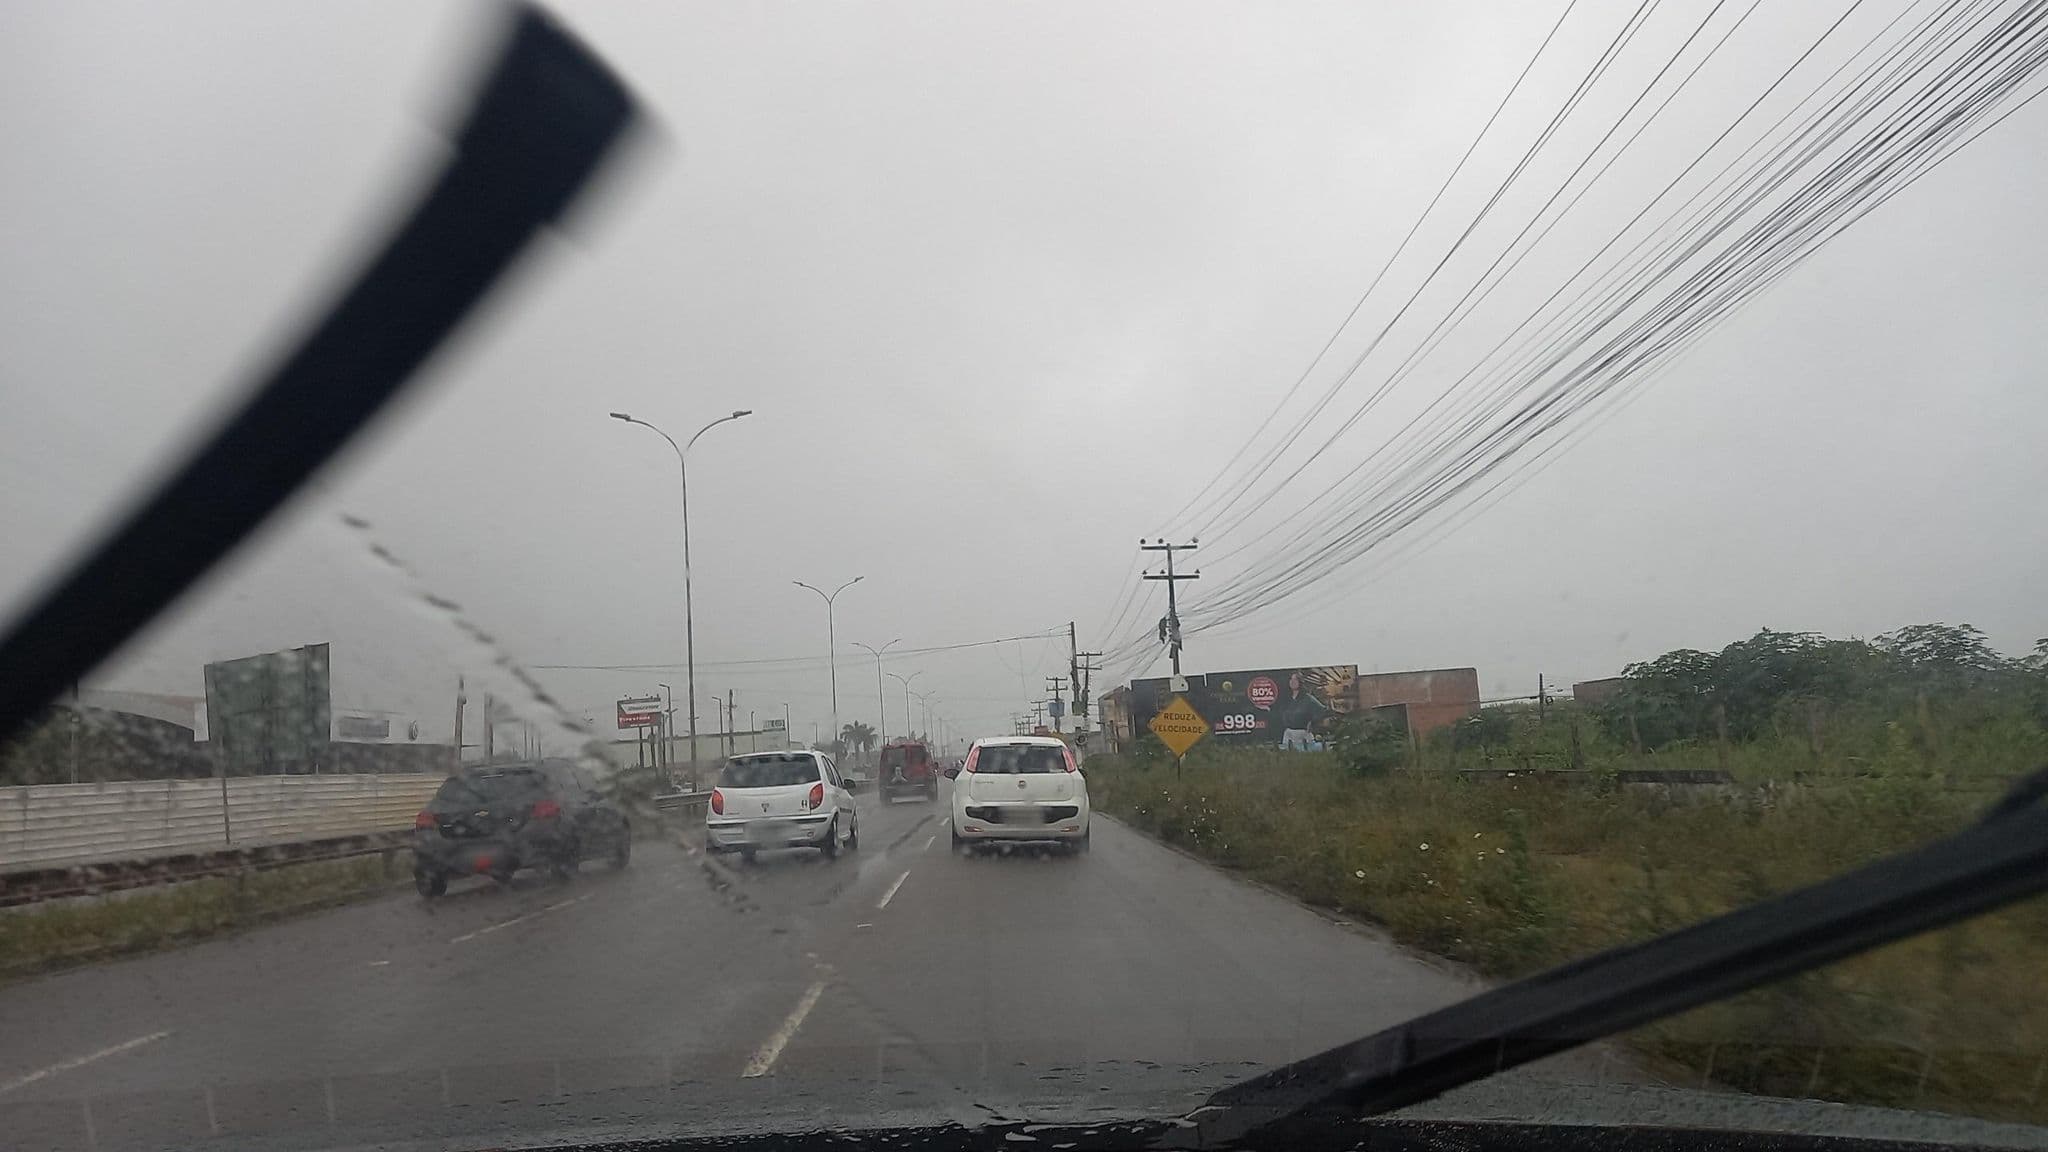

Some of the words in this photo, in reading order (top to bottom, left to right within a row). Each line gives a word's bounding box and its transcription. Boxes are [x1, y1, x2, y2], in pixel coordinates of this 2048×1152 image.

[1252, 687, 1274, 697] 80%
[1163, 712, 1197, 721] REDUZA
[1224, 714, 1255, 729] 998
[1153, 724, 1204, 734] VELOCIDADE
